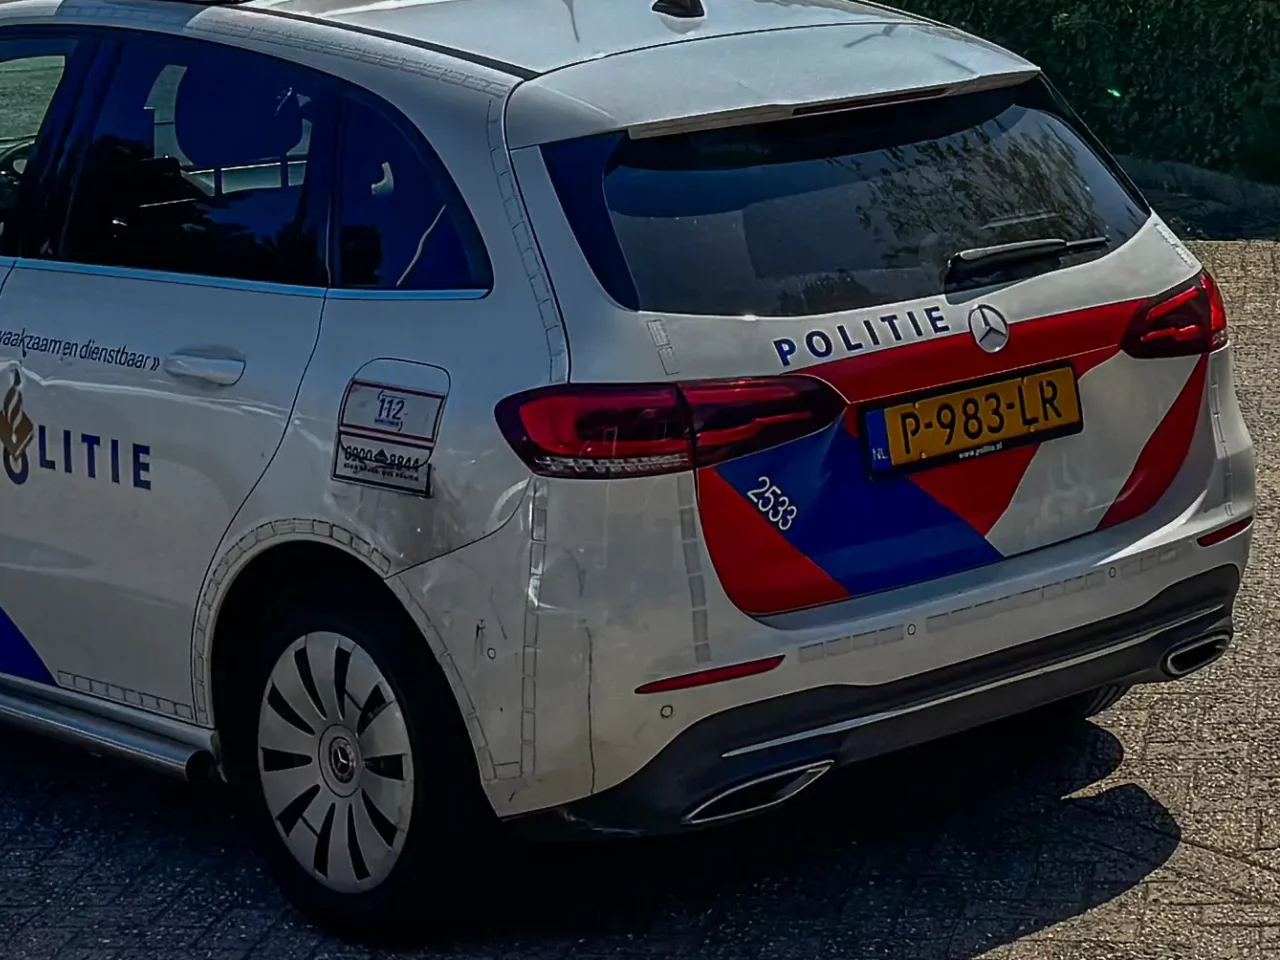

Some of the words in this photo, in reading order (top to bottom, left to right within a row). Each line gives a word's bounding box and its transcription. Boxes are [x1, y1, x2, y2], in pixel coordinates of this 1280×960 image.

[62, 340, 78, 359] en
[773, 306, 950, 367] POLITIE
[377, 397, 405, 421] 112
[900, 379, 1063, 455] P-983-LR
[871, 447, 889, 461] NL
[746, 476, 797, 530] 2533
